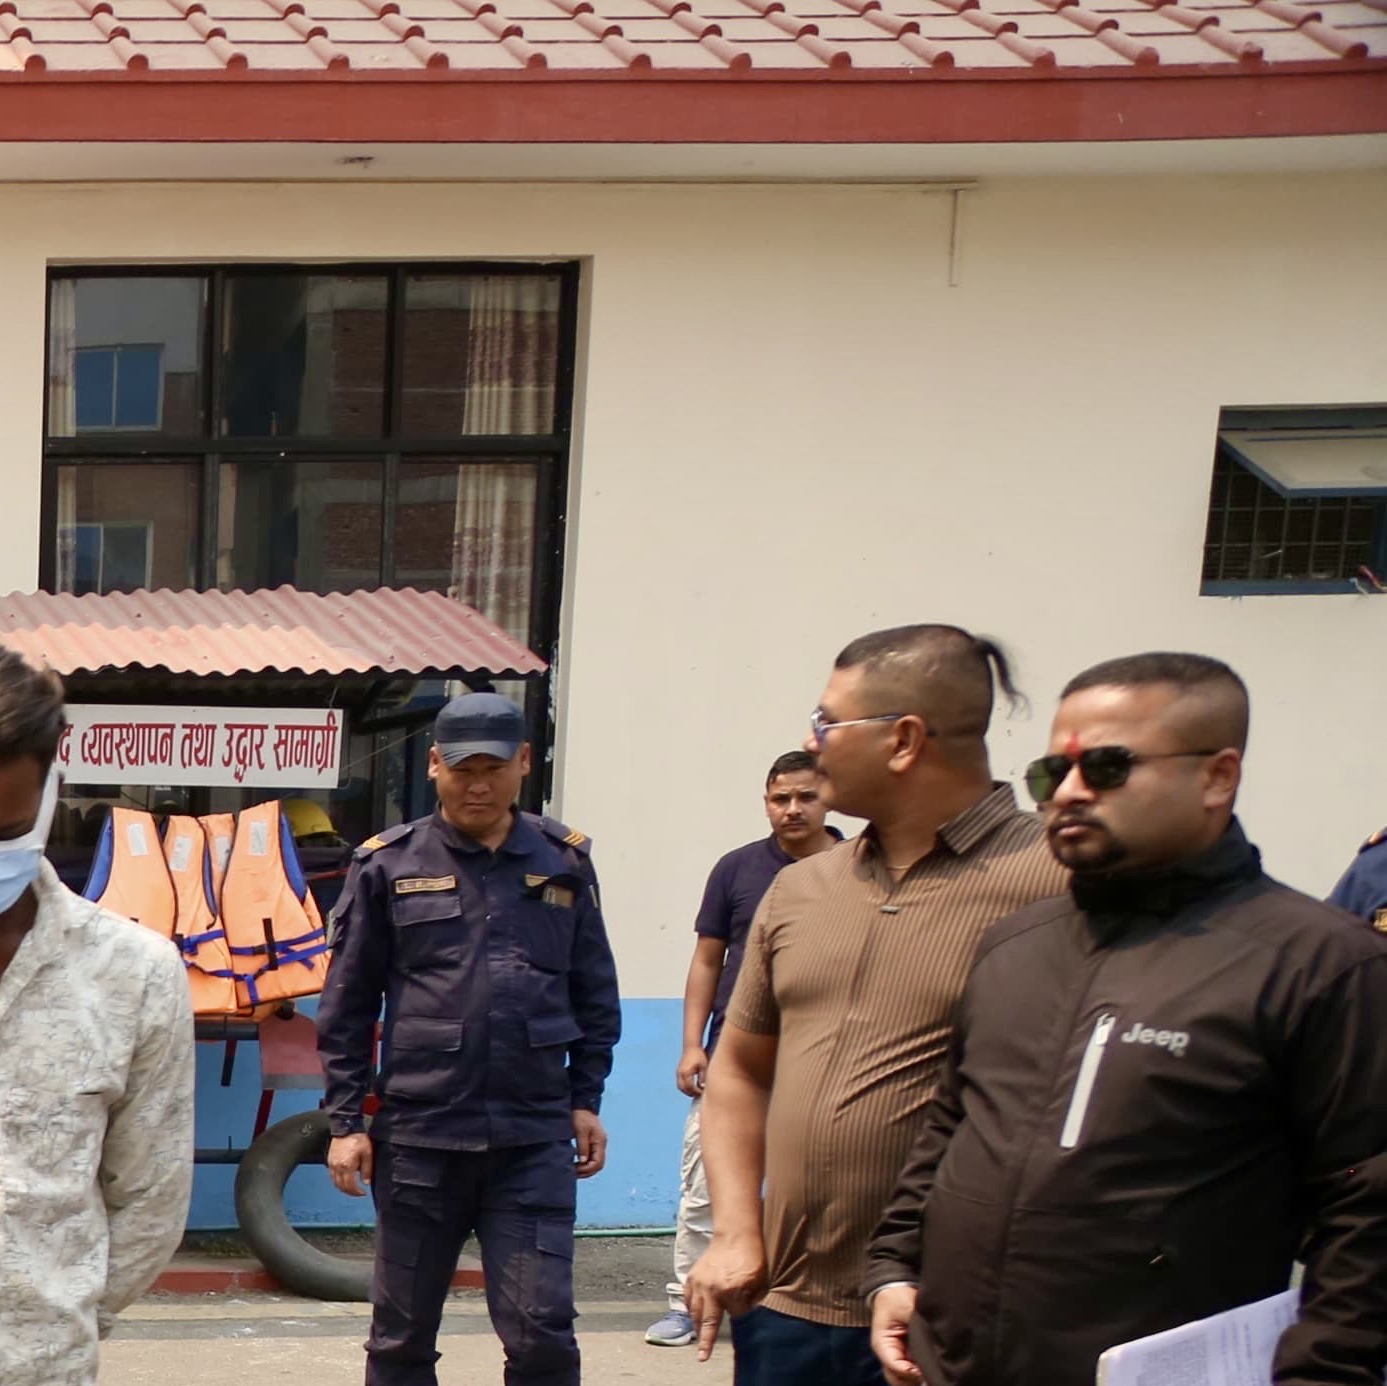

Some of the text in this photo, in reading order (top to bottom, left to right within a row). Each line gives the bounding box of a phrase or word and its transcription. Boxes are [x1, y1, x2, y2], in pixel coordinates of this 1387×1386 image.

[81, 723, 176, 769] व्यवस्थापन
[180, 723, 218, 768] तथा
[273, 710, 339, 775] सामाग्री
[1121, 1022, 1190, 1051] Jeep
